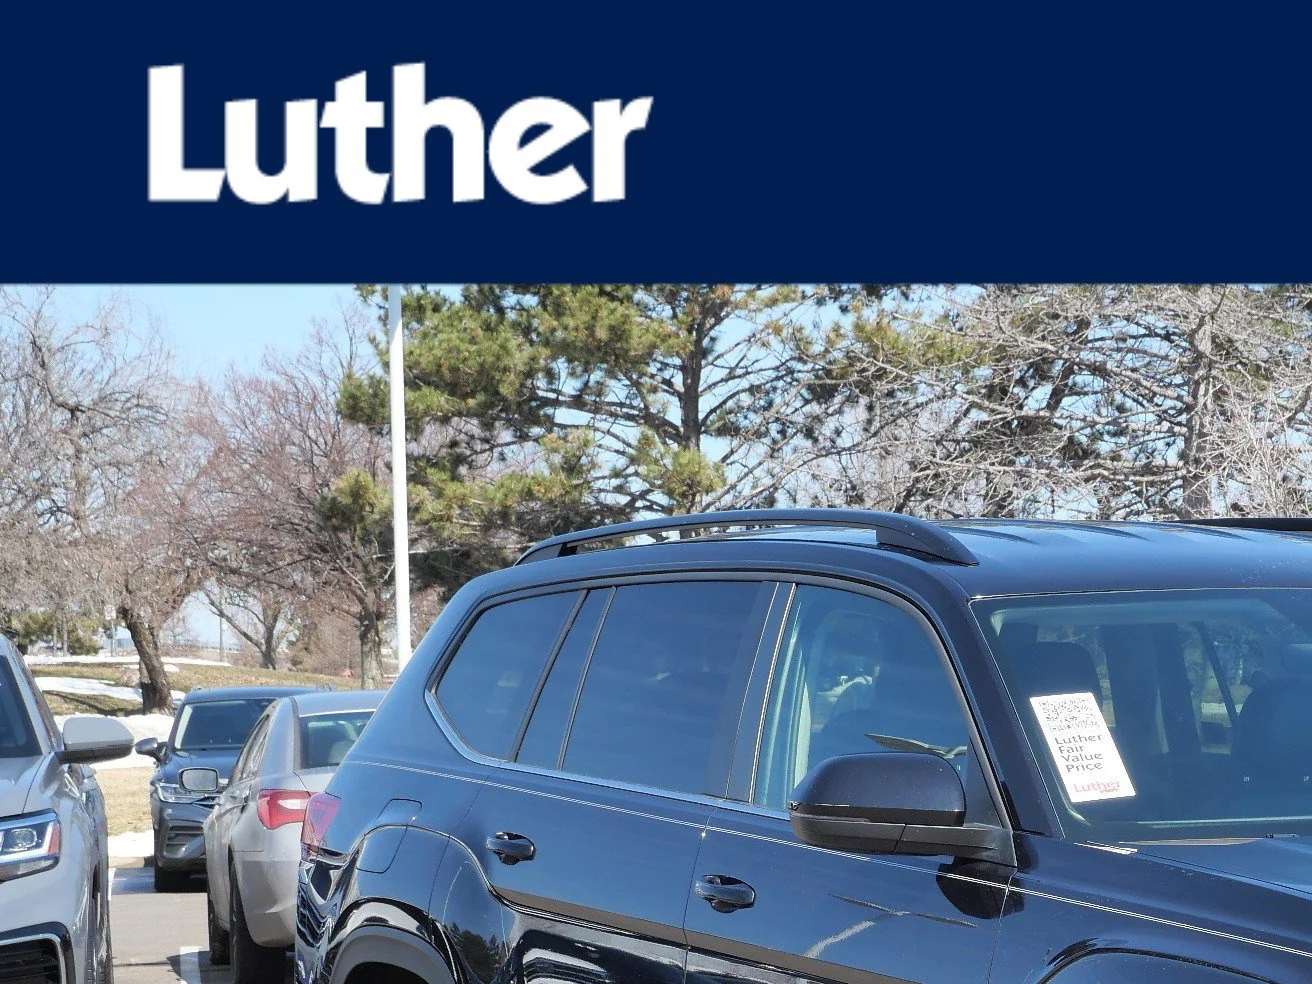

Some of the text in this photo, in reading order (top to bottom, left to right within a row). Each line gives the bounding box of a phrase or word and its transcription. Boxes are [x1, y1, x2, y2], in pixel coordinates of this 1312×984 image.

[1054, 733, 1103, 745] Luther
[1058, 744, 1084, 754] Fair
[1061, 752, 1104, 763] Value
[1065, 762, 1104, 773] Price
[1073, 780, 1121, 793] Luther
